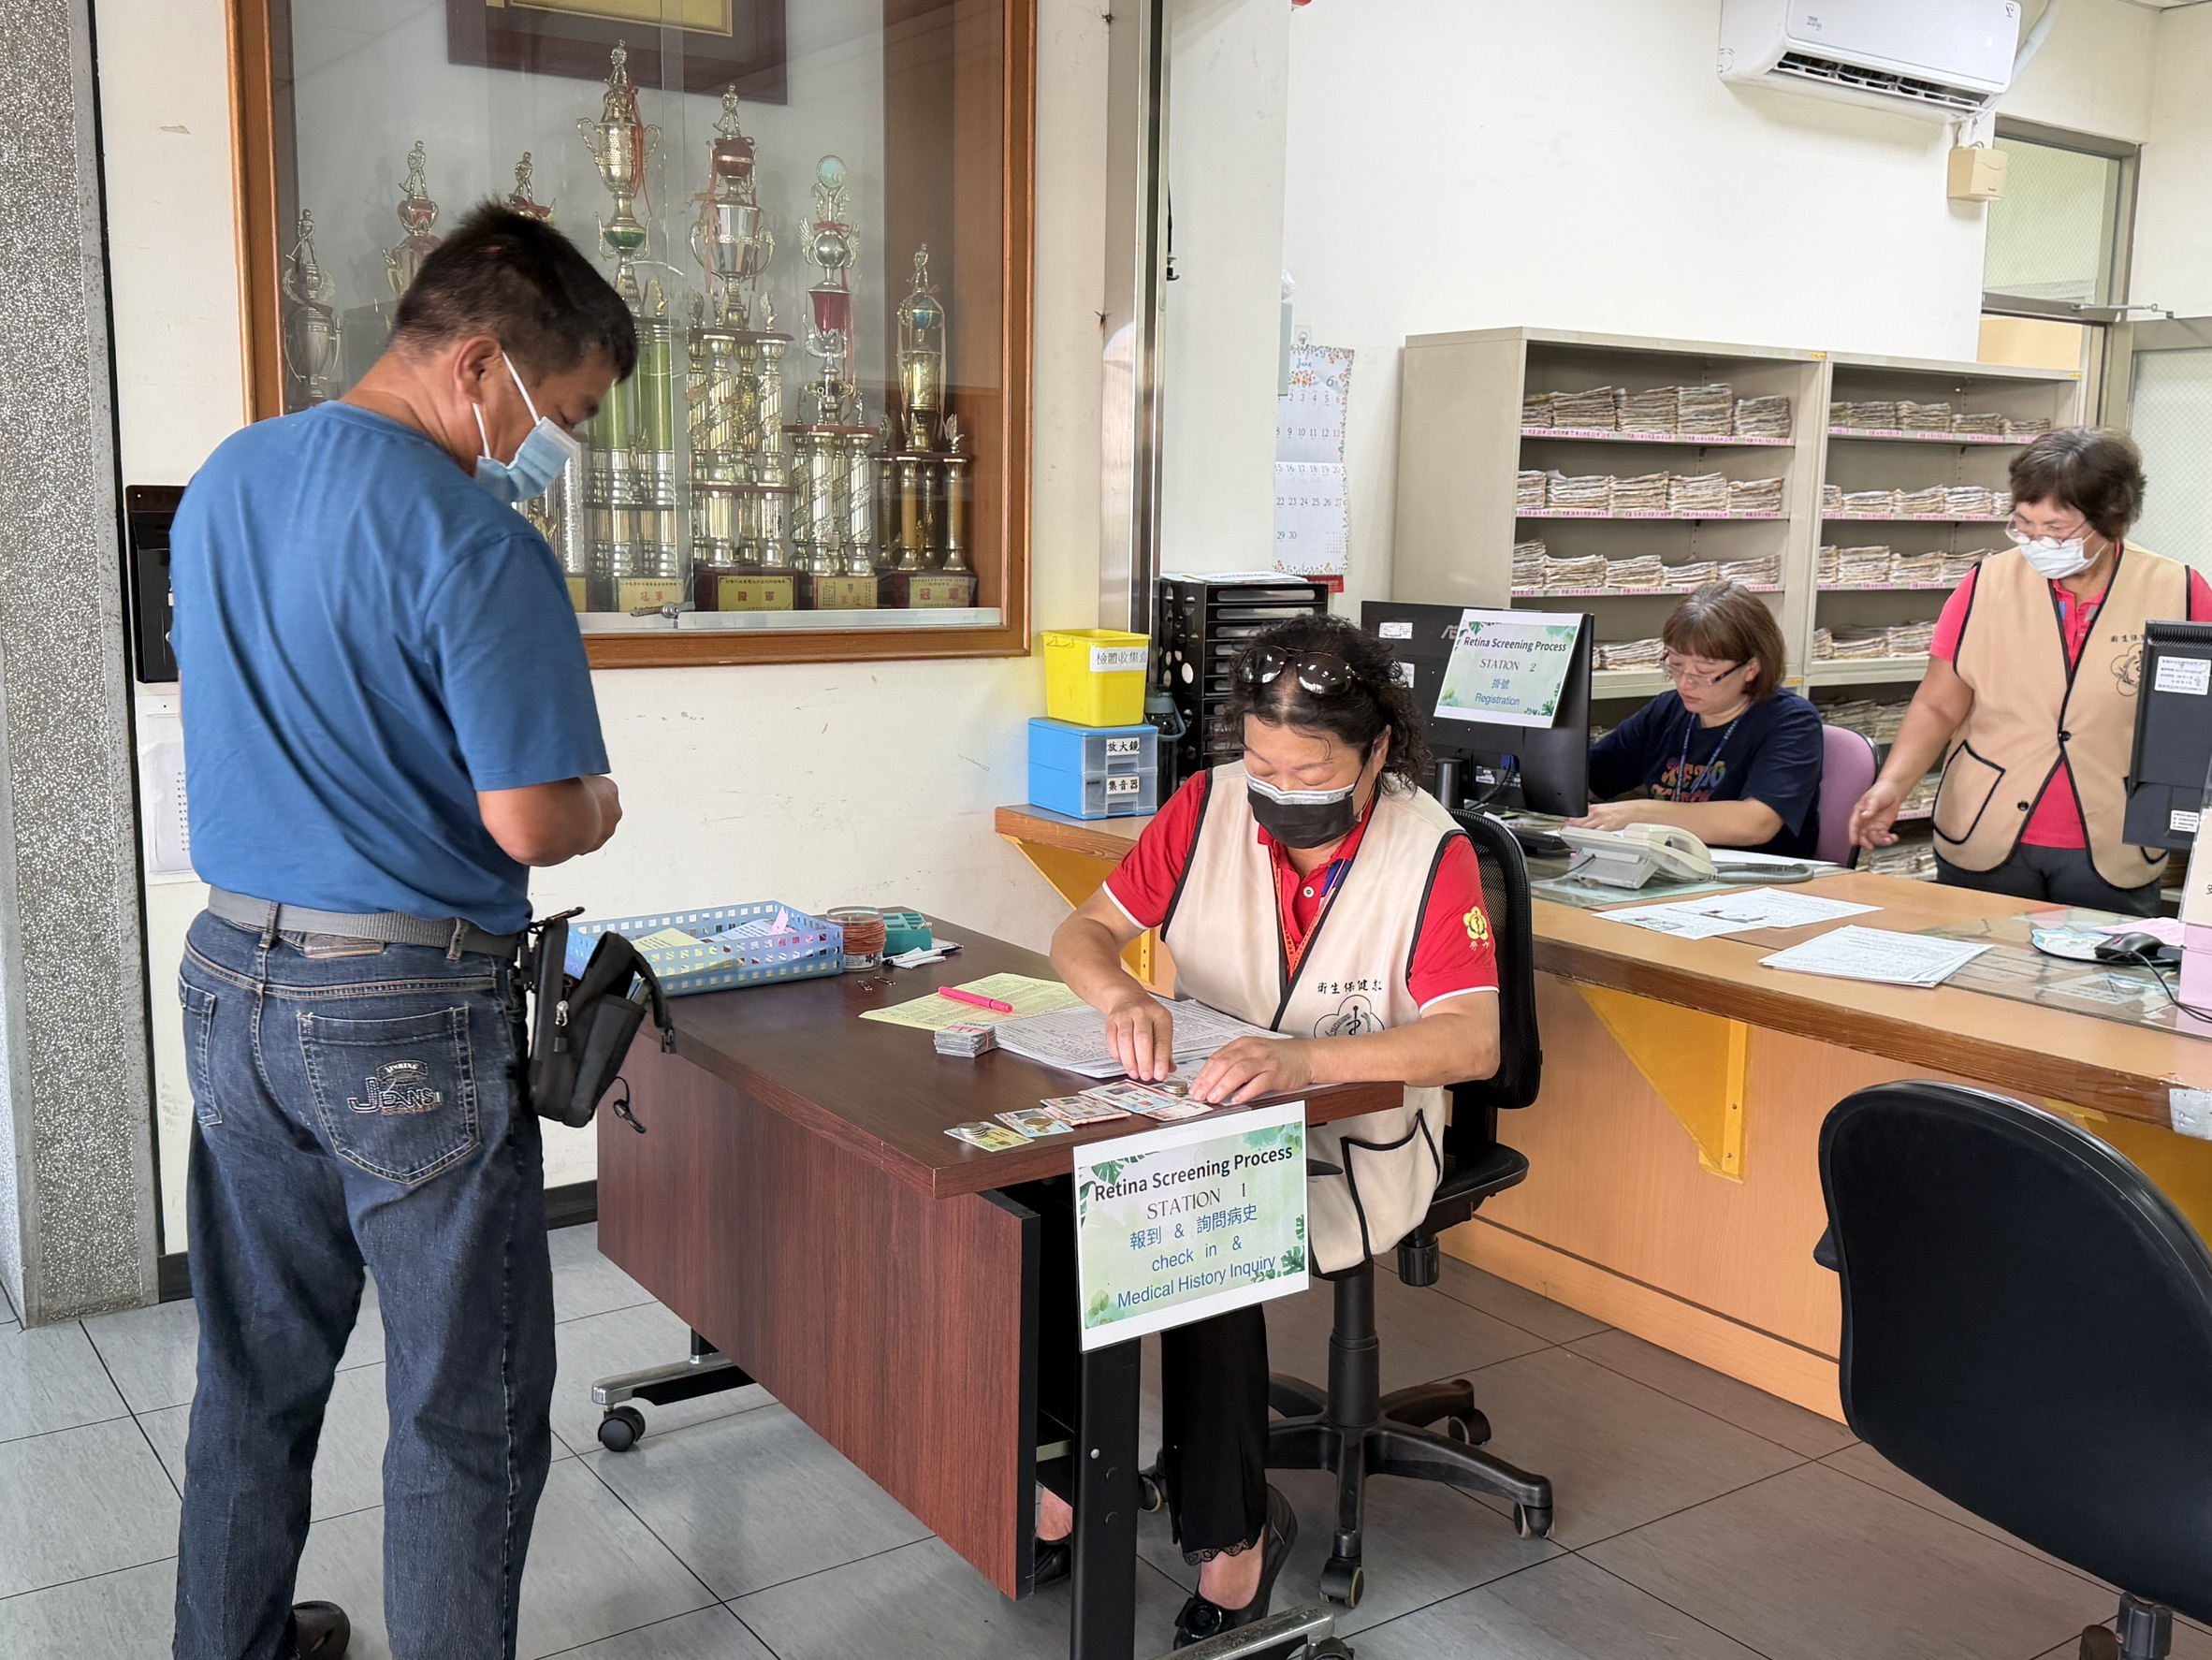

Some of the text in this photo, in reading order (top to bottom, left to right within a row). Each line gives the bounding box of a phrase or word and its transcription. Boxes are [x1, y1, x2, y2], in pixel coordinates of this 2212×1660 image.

[1289, 393, 1294, 401] 2
[1301, 393, 1305, 402] 3
[1324, 395, 1330, 403] 5
[1288, 428, 1292, 436] 9
[1298, 428, 1306, 437] 10
[1310, 429, 1317, 437] 11
[1321, 429, 1330, 438] 12
[1333, 430, 1341, 438] 13
[1287, 464, 1295, 473] 16
[1298, 464, 1305, 473] 17
[1310, 465, 1318, 473] 18
[1321, 465, 1330, 473] 19
[1332, 465, 1341, 473] 20
[1276, 497, 1343, 506] 22 23 24 25 26 27
[1276, 531, 1297, 539] 29 30
[1463, 636, 1567, 653] Retina Screening Process
[1479, 659, 1536, 672] STATION 2
[1492, 677, 1510, 691] 掛號
[1475, 692, 1521, 706] Registration
[1107, 740, 1140, 752] 放大鏡
[1108, 779, 1139, 792] 集音器
[1095, 1145, 1293, 1201] Retina Screening Process
[1146, 1188, 1221, 1220] STATION
[1129, 1203, 1258, 1251] 報到 & 詢問病史
[1152, 1235, 1243, 1273] check in &
[1117, 1255, 1276, 1309] Medical History Inquiry
